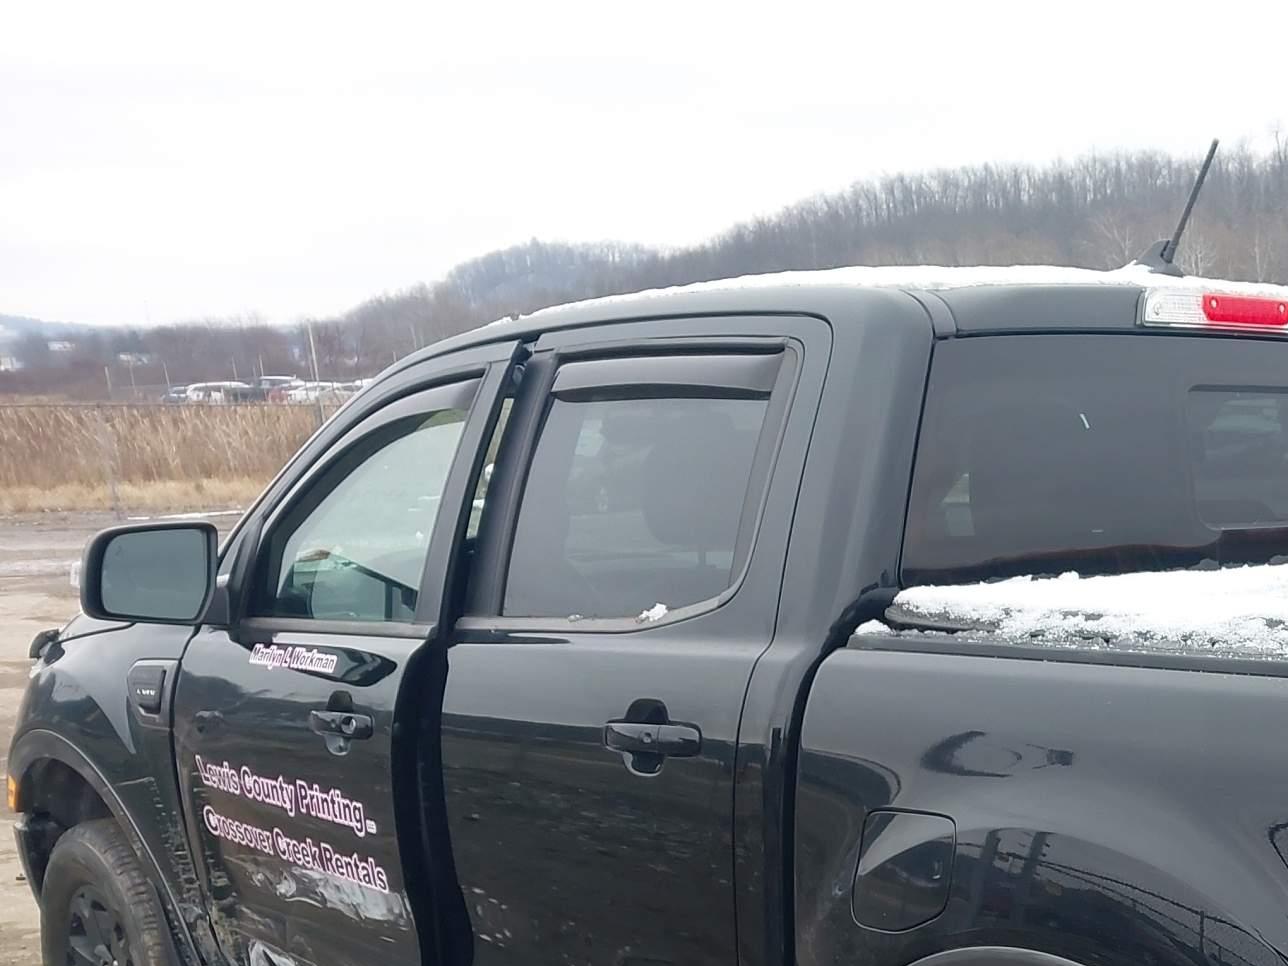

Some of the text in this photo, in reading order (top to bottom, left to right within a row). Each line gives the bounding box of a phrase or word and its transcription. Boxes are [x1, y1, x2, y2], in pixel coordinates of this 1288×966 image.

[249, 643, 285, 670] Marilyn
[289, 647, 337, 673] Workman
[195, 755, 365, 837] Lewis County Printing
[203, 805, 389, 893] Crossover Creek Rentals
